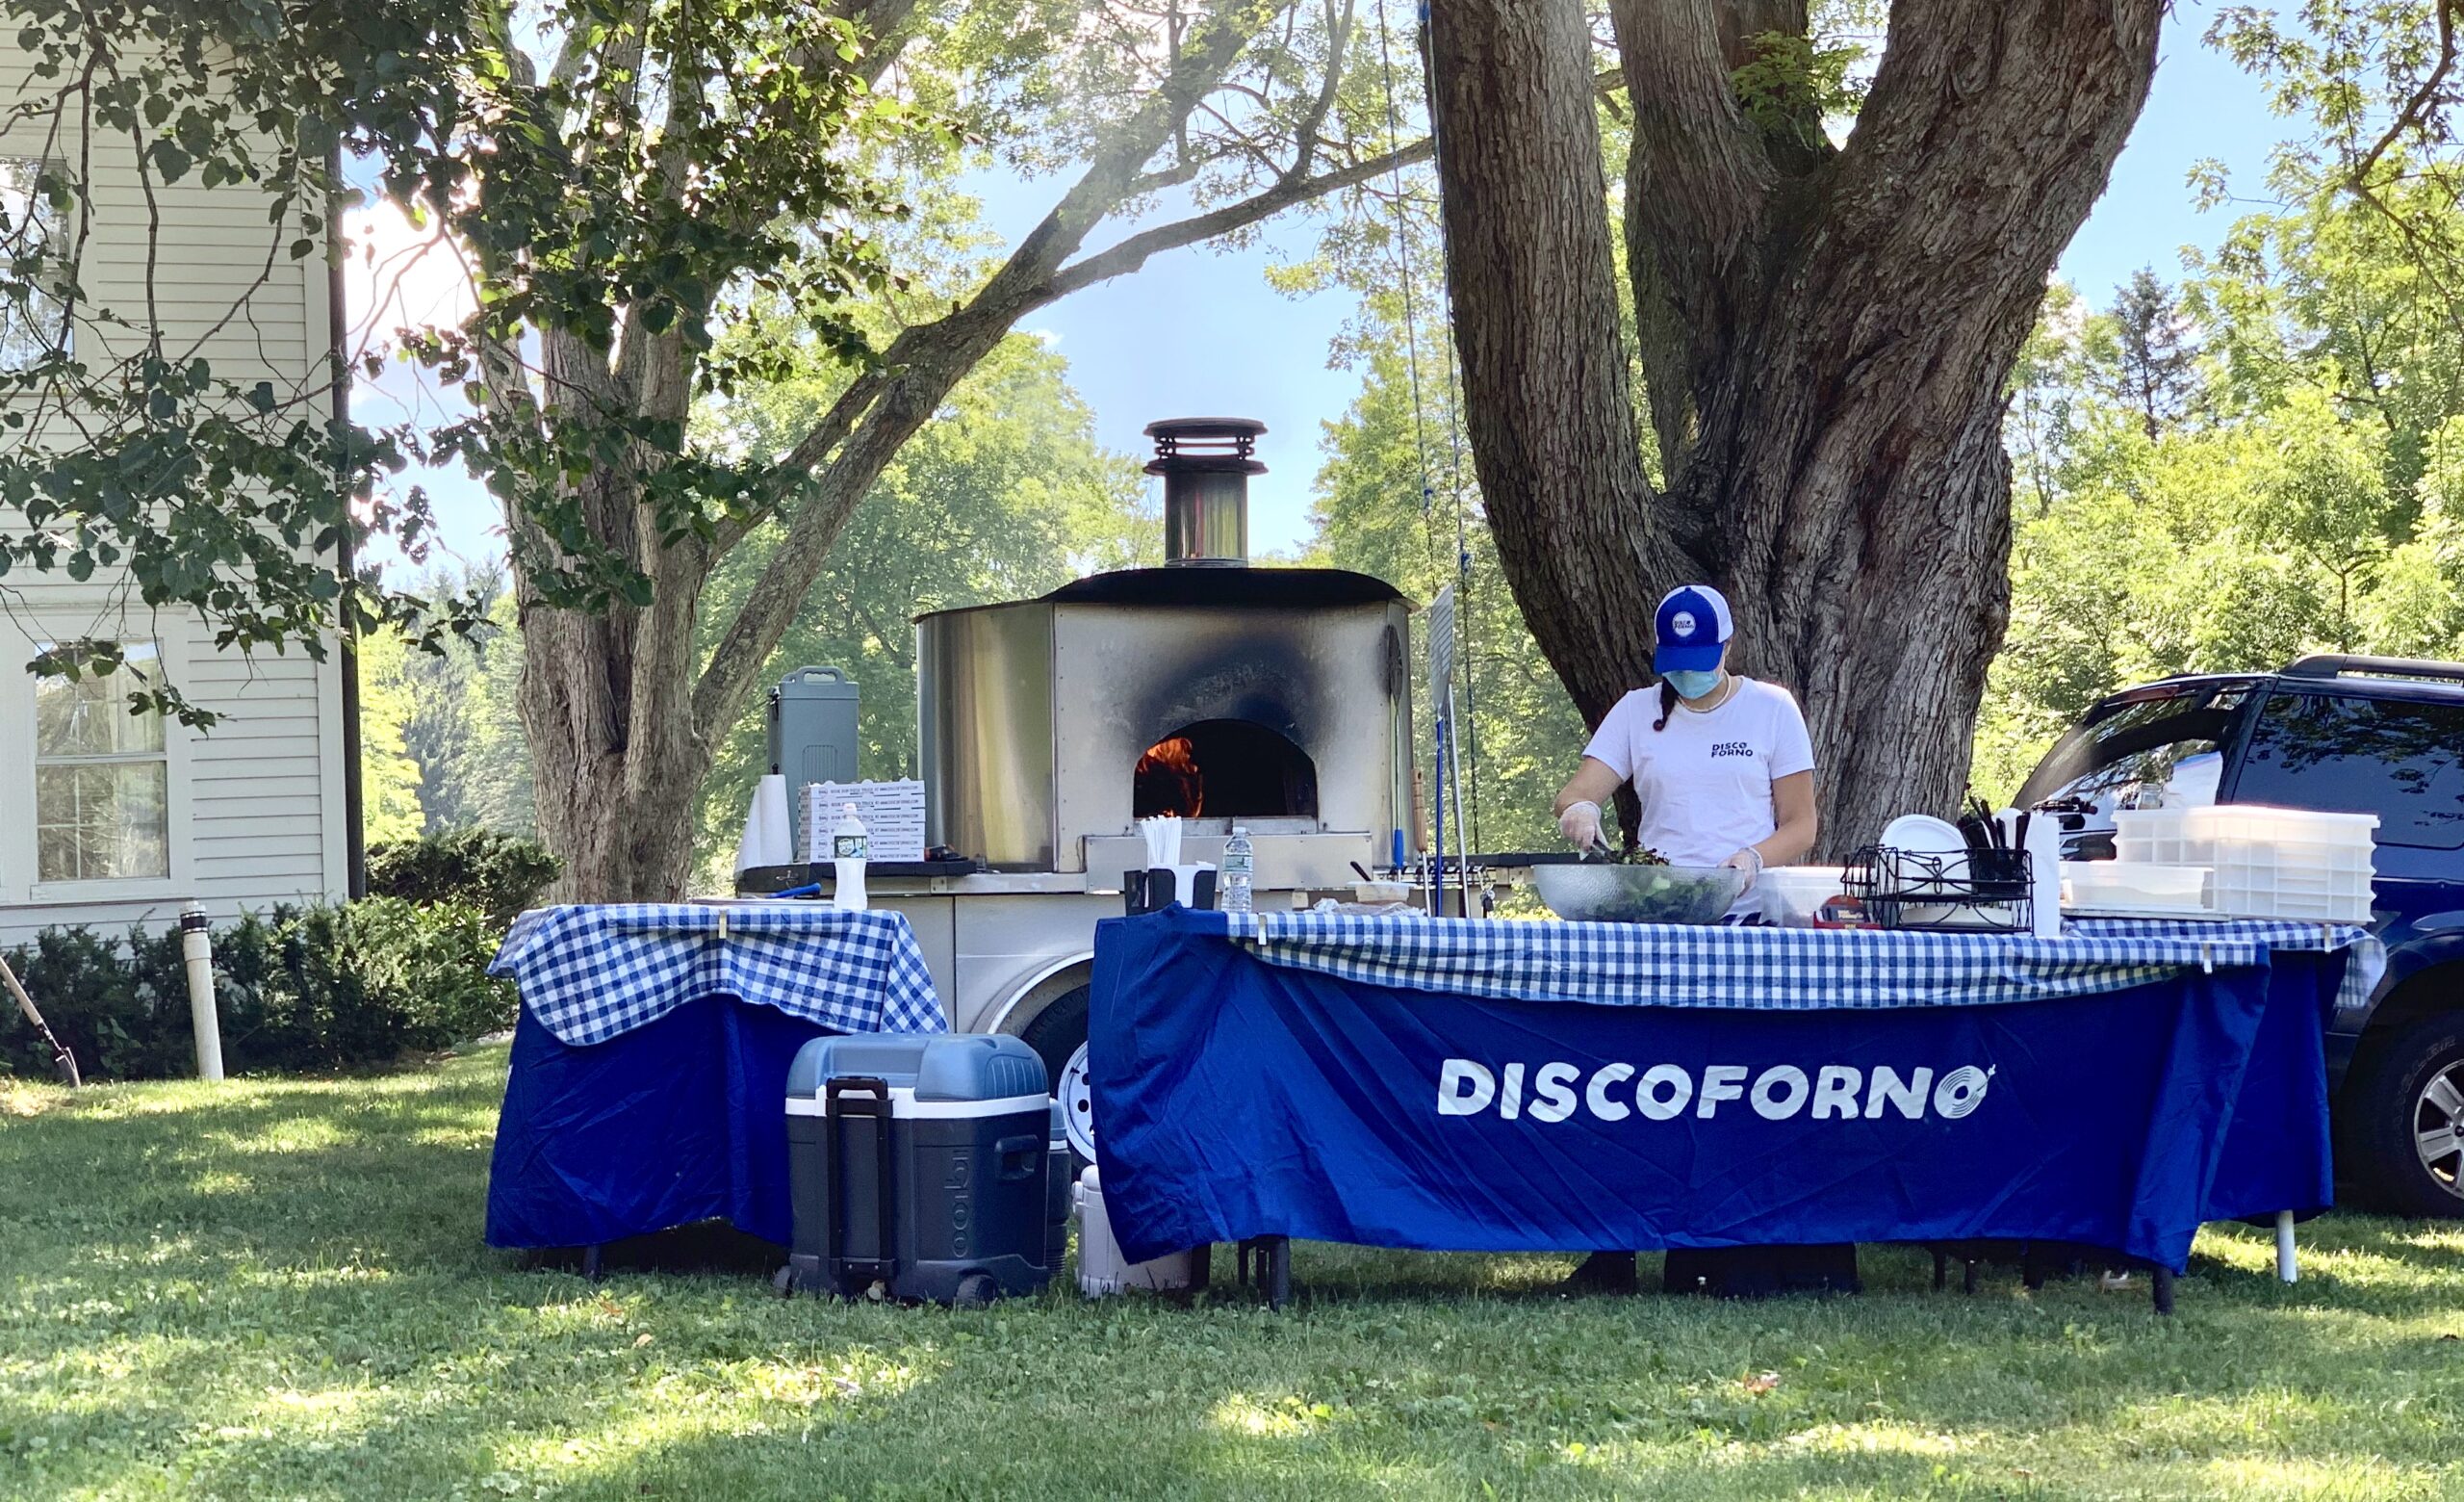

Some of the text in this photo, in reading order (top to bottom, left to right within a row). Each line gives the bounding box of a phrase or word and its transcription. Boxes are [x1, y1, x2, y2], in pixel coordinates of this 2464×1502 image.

[1711, 741, 1747, 751] DISCO
[1710, 749, 1754, 758] FORNO
[1437, 1058, 1992, 1123] DISCOFORNO
